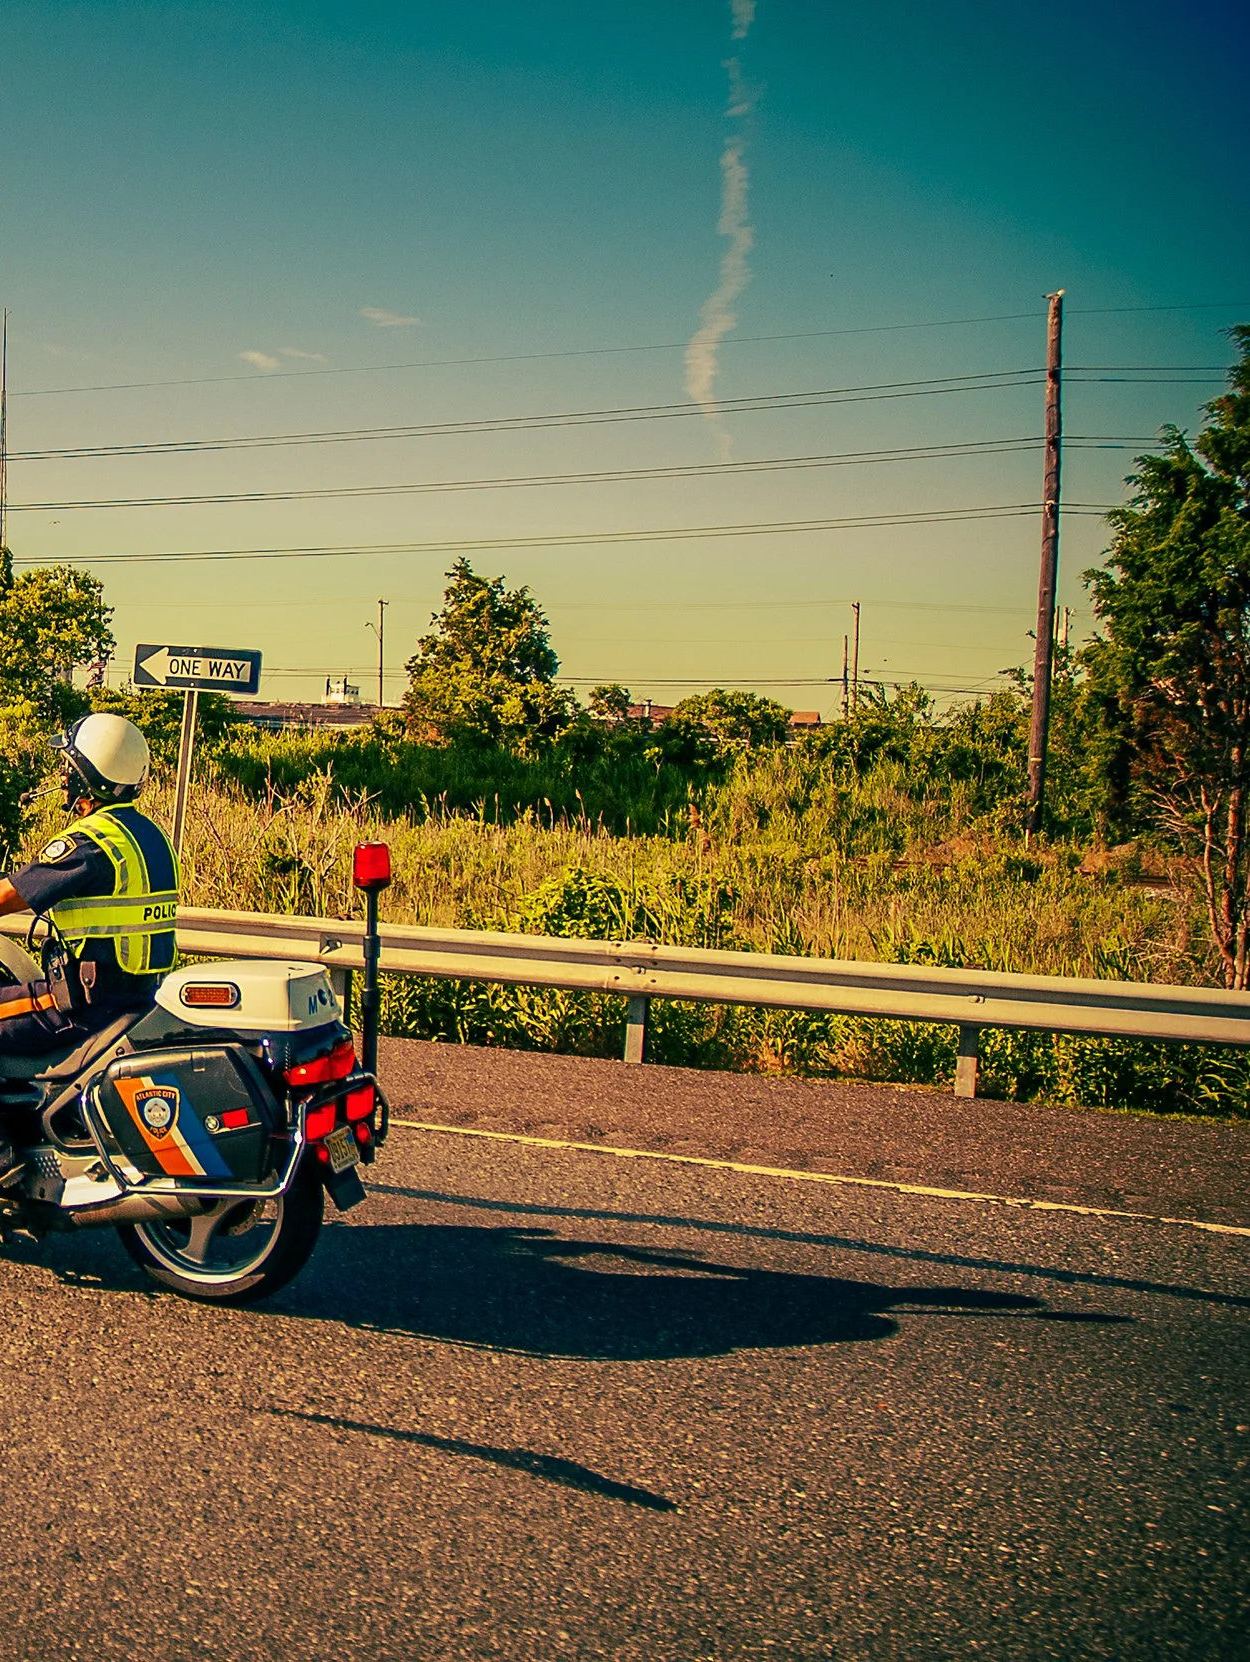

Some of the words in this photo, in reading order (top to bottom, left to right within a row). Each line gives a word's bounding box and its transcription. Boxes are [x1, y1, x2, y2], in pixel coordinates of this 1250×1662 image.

[169, 658, 201, 676] ONE
[209, 661, 246, 679] WAY
[136, 1090, 162, 1101] ATLANTIC
[162, 1090, 176, 1099] CITY
